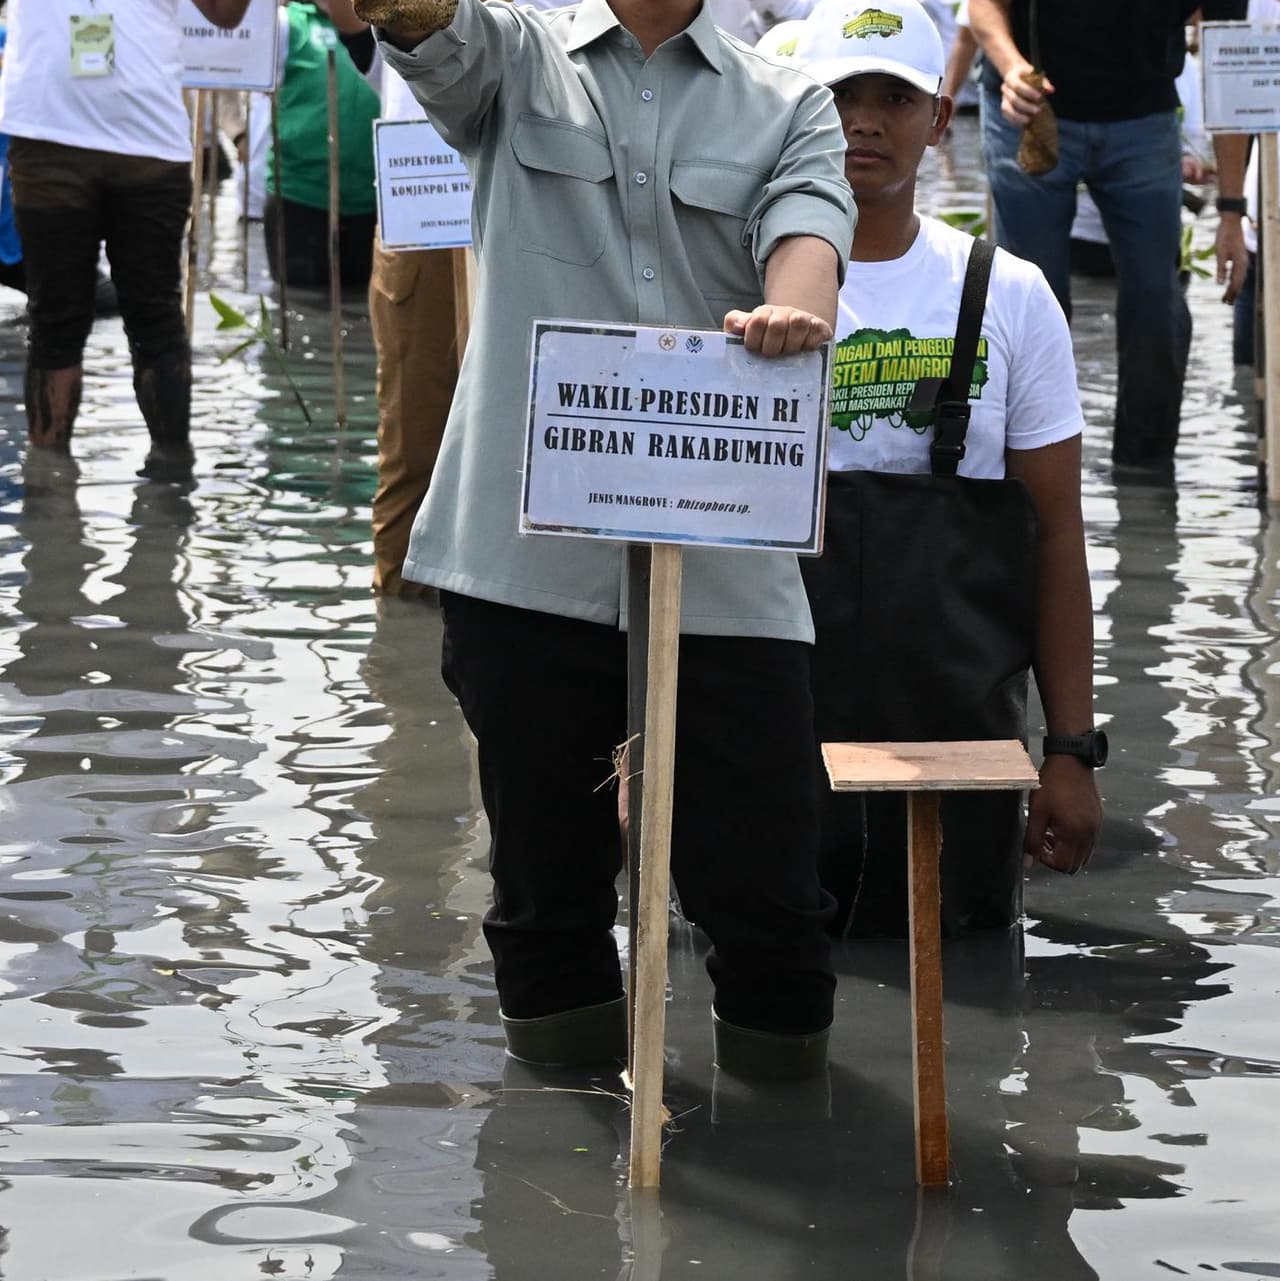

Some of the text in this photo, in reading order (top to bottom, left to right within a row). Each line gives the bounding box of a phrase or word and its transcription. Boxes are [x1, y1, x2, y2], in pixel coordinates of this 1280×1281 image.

[388, 154, 454, 168] INSPEKTORAT
[391, 183, 448, 197] KOMJENPOL
[835, 342, 875, 363] NGAN
[877, 340, 902, 358] DAN
[880, 358, 951, 382] MANGRO
[557, 382, 799, 423] WAKIL PRESIDEN RI
[851, 385, 894, 397] PRESIDEN
[848, 396, 906, 411] MASYARAKAT
[544, 426, 804, 467] GIBRAN RAKABUMING
[588, 492, 613, 504] JENIS
[615, 494, 667, 508] MANGROVE
[677, 498, 736, 513] Rhizophora
[737, 504, 751, 515] sp.
